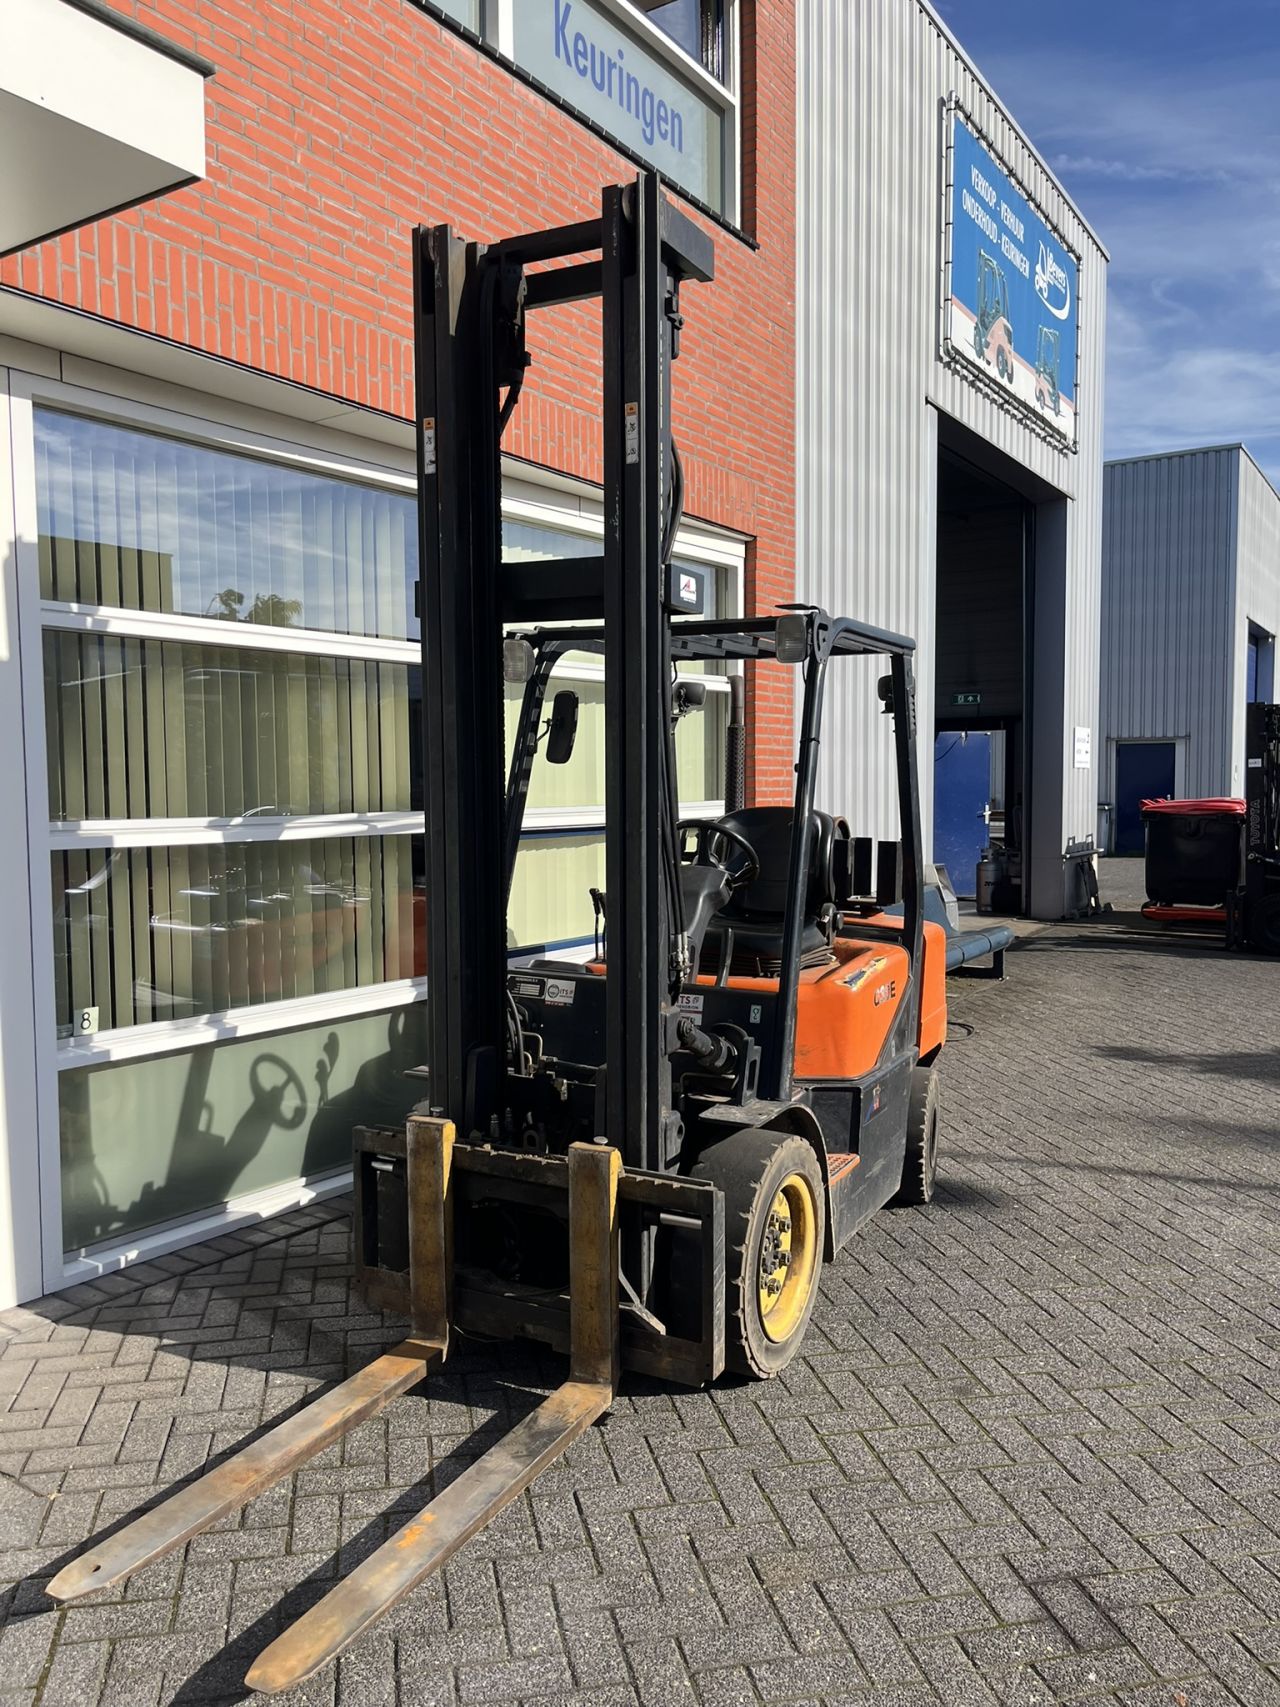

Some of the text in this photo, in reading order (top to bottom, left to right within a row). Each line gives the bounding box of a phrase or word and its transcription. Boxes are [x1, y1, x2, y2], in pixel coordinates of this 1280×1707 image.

[554, 0, 683, 153] Keuringen
[962, 188, 998, 243] ONDERHOUD
[1001, 232, 1029, 280] KEURINGEN
[971, 164, 997, 210] VERKOOP
[1001, 200, 1024, 244] VERHUUR
[81, 1011, 91, 1030] 8
